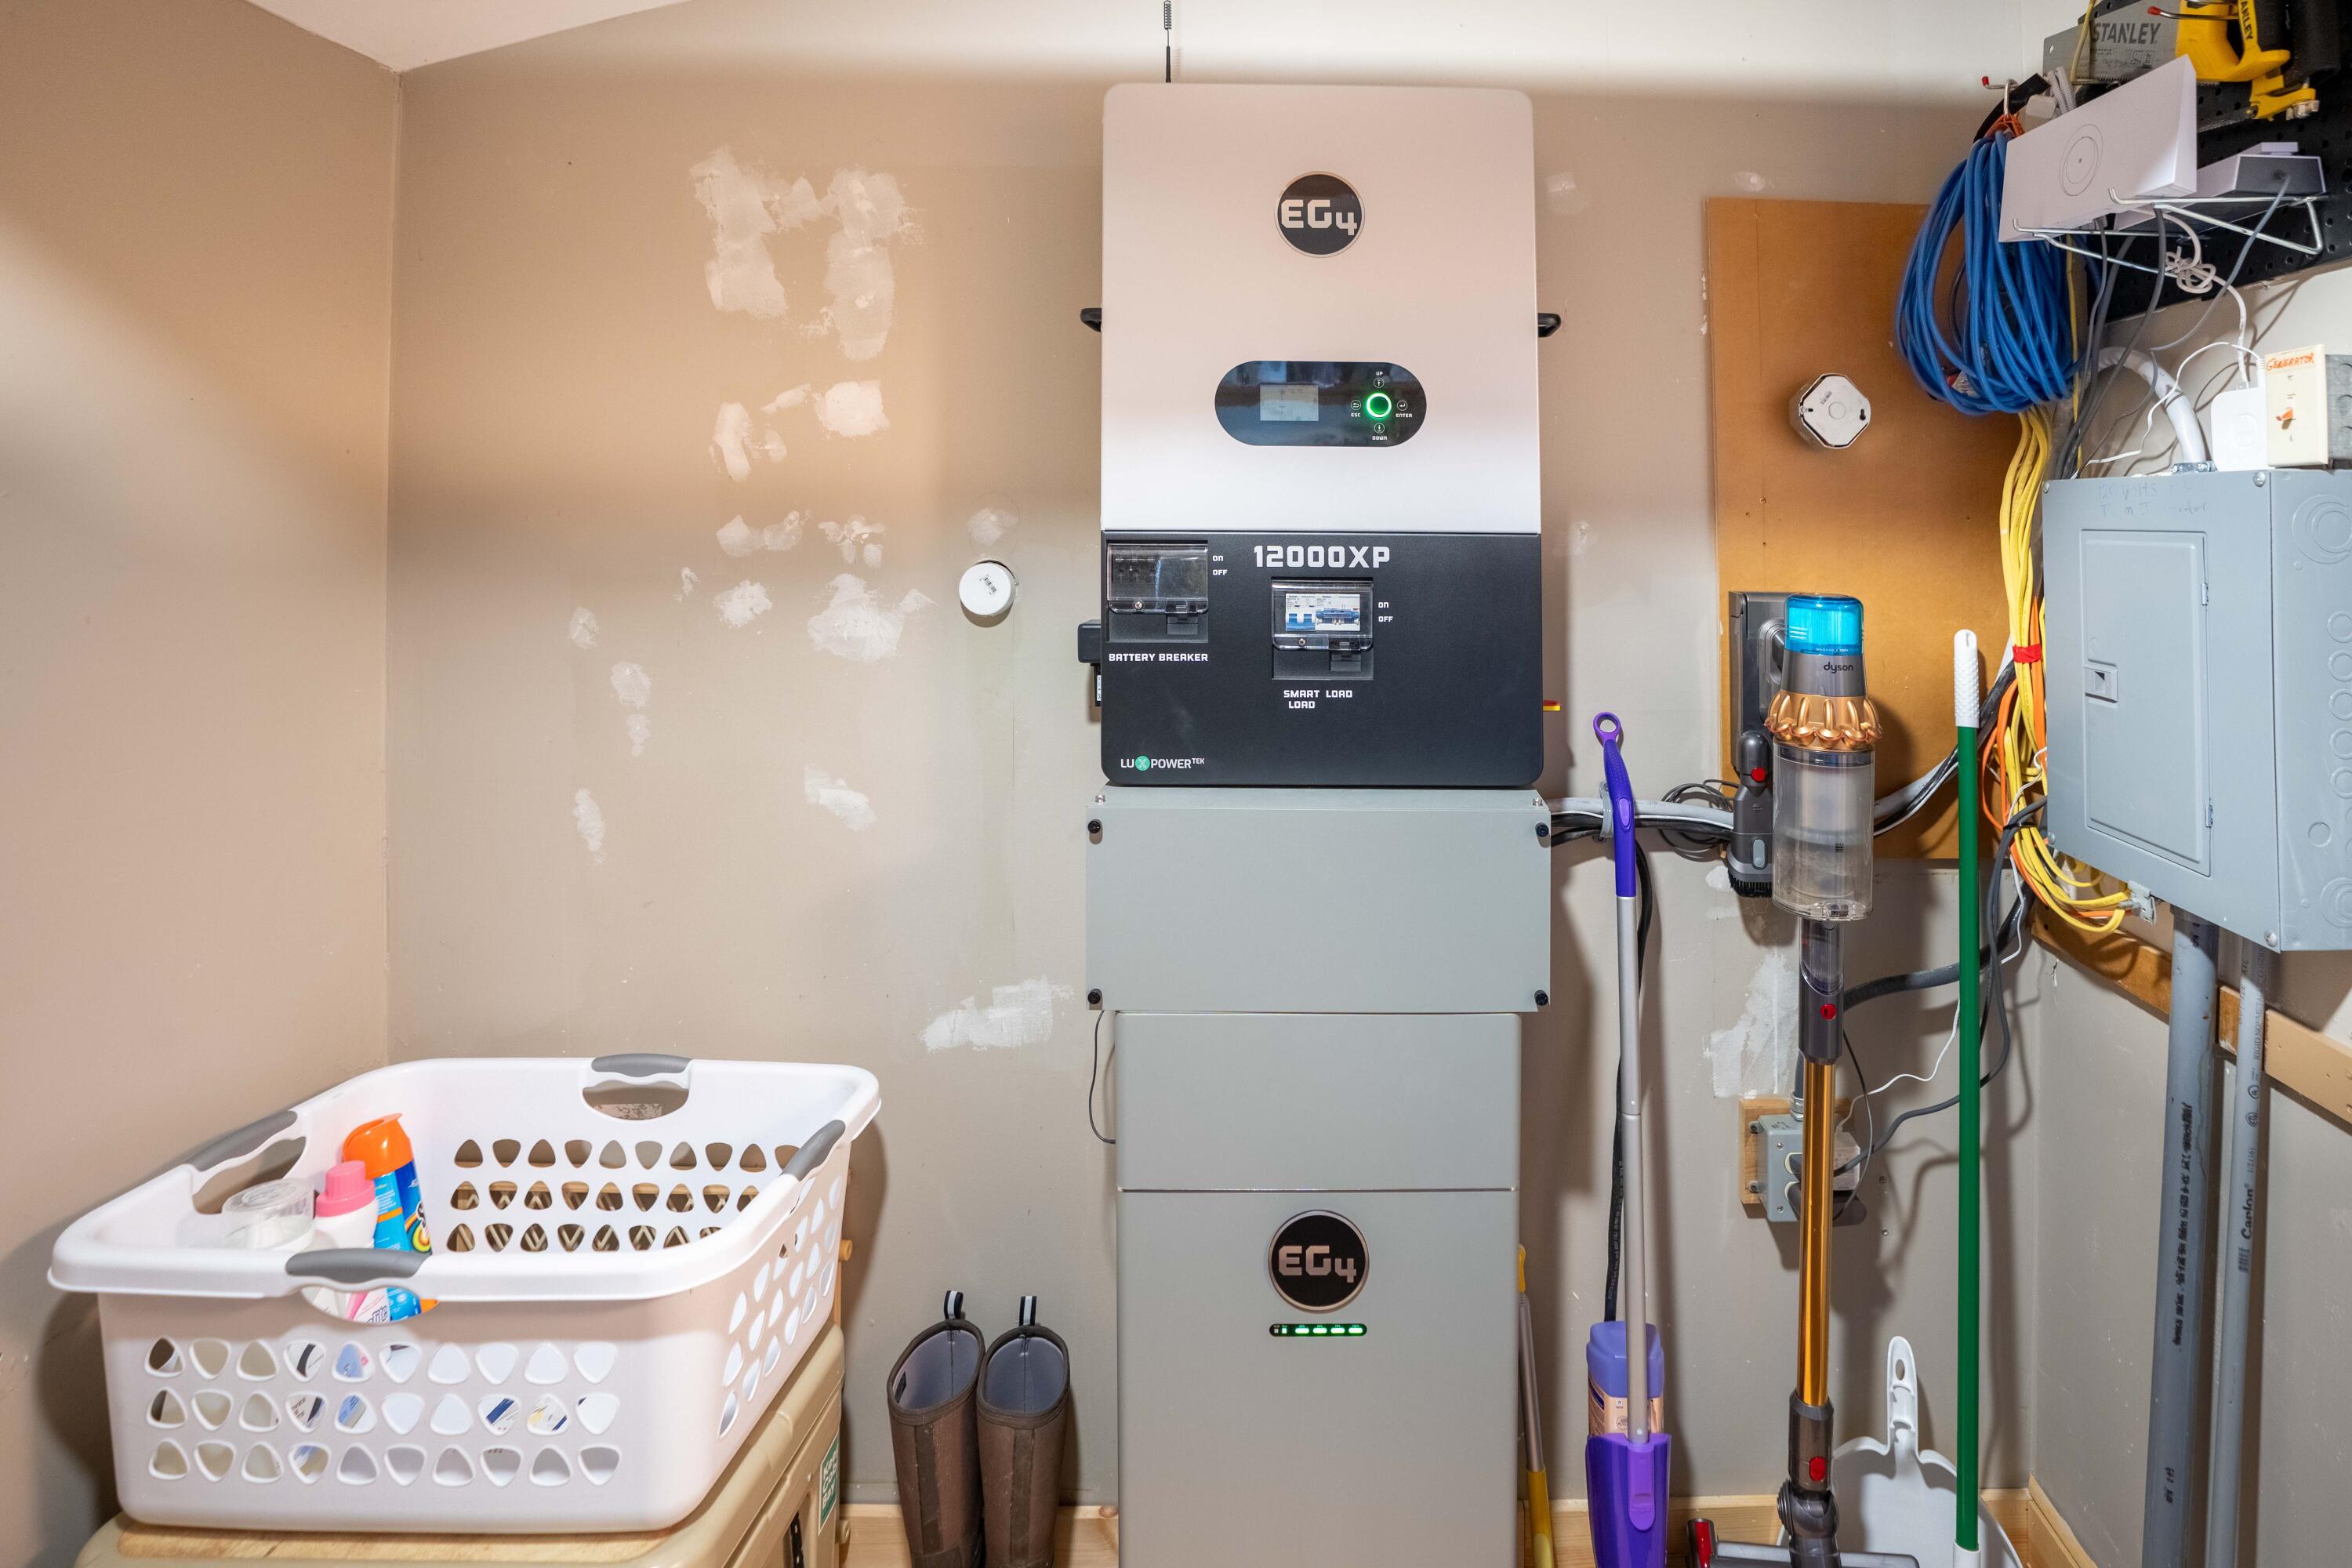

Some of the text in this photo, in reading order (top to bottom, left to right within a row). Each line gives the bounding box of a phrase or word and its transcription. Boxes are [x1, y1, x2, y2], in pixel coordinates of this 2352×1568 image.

[2240, 0, 2253, 40] ANLEY
[2092, 23, 2161, 45] STANLEY
[1280, 199, 1358, 236] EG4
[2266, 351, 2314, 372] GENERATOR
[1254, 545, 1390, 568] 12000XP
[1109, 653, 1208, 662] BATTERY BREAKER
[1824, 662, 1853, 673] dyson
[1283, 689, 1353, 698] SMART LOAD
[1278, 1245, 1357, 1283] EG4
